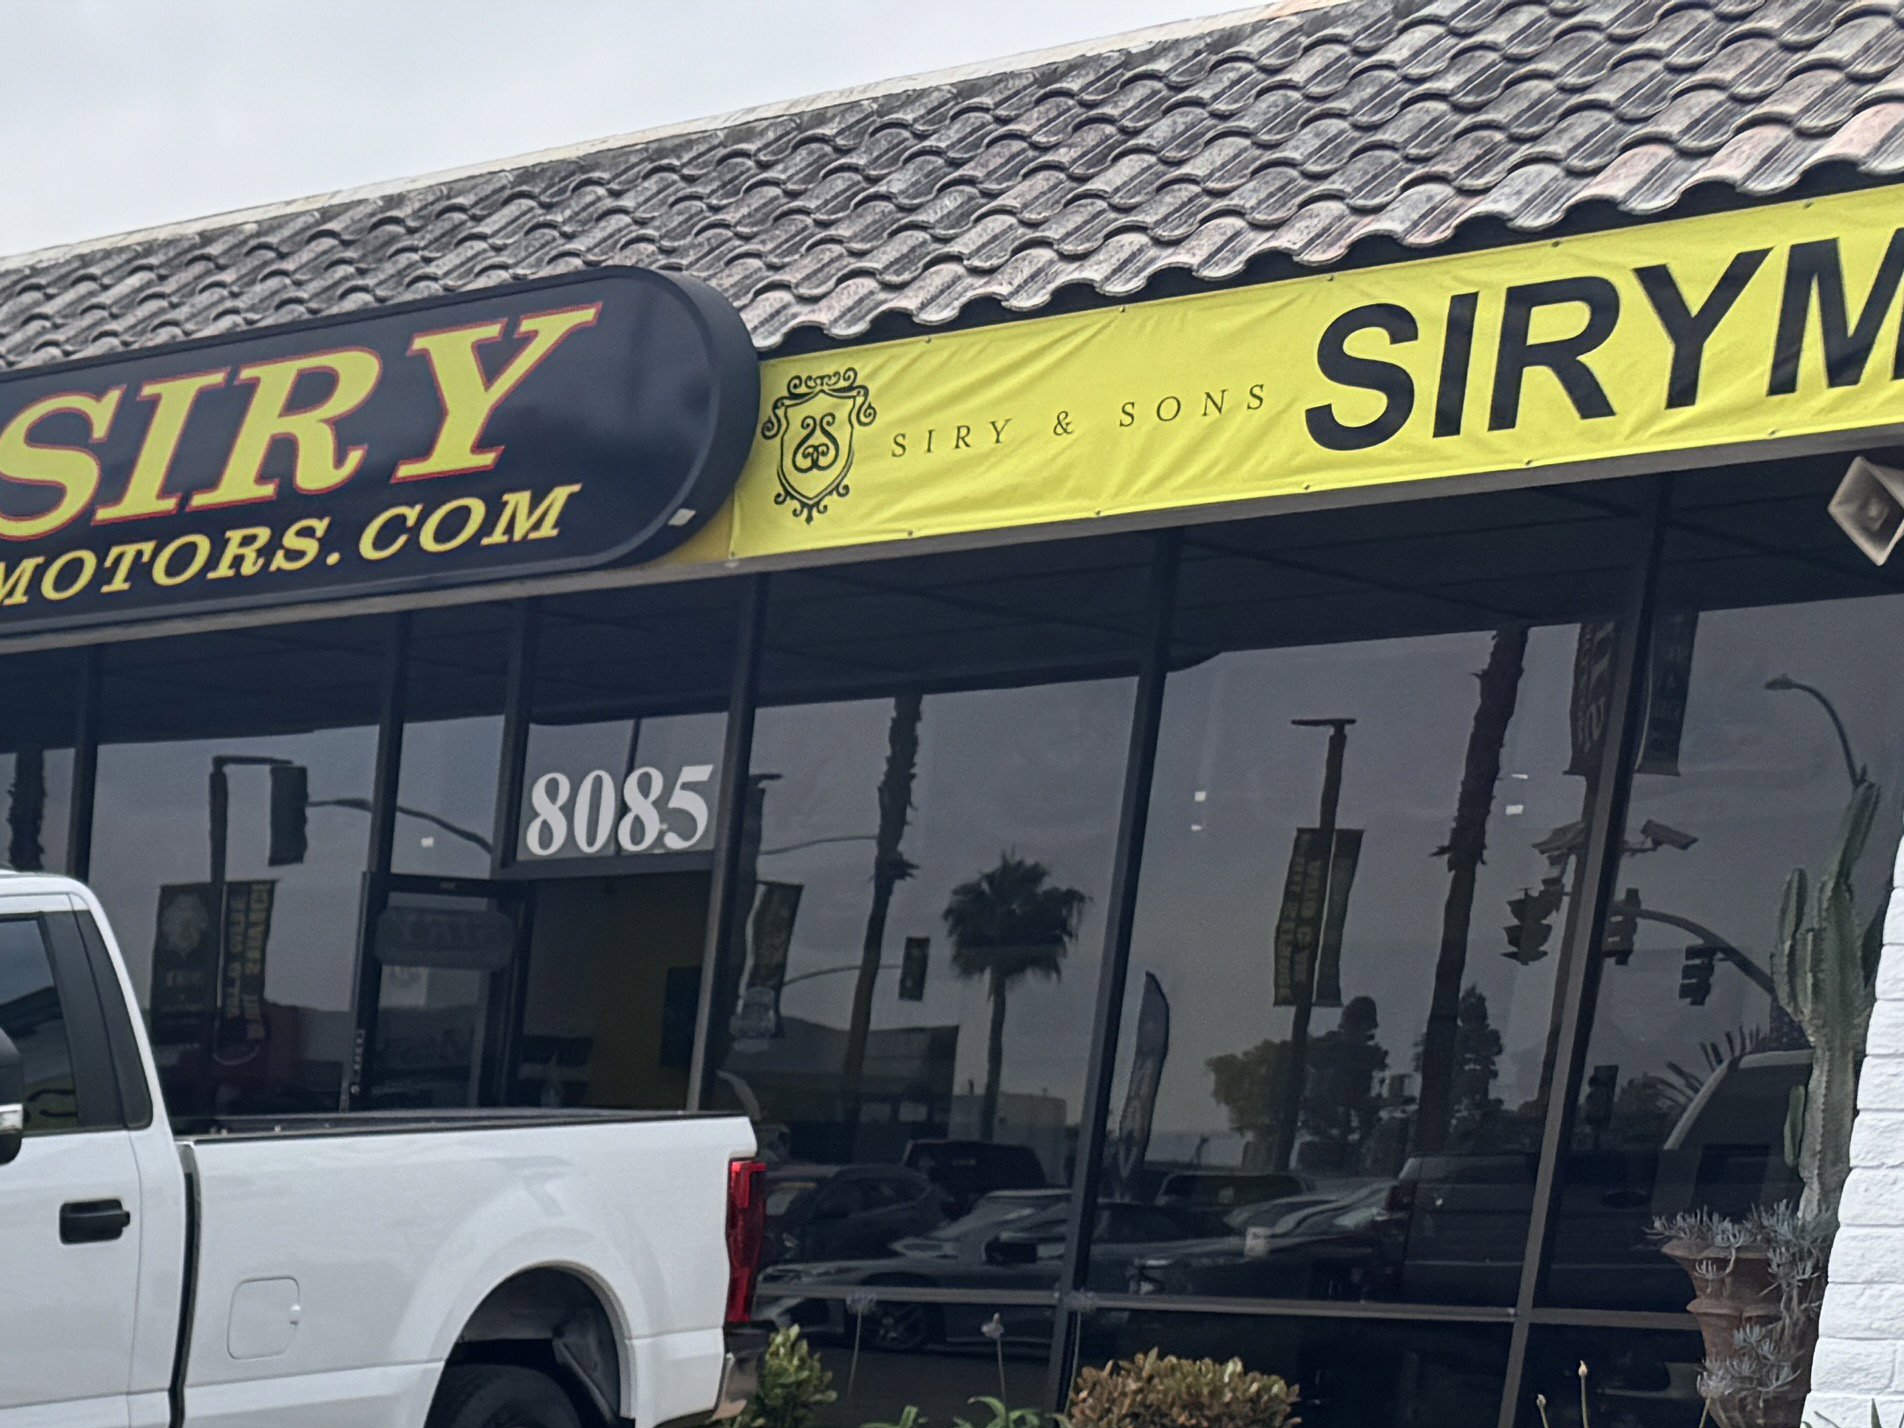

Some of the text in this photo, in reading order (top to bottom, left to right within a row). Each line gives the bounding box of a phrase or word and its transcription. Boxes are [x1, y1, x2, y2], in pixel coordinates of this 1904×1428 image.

[890, 382, 1268, 460] SIRY & SONS
[526, 765, 714, 856] 8085
